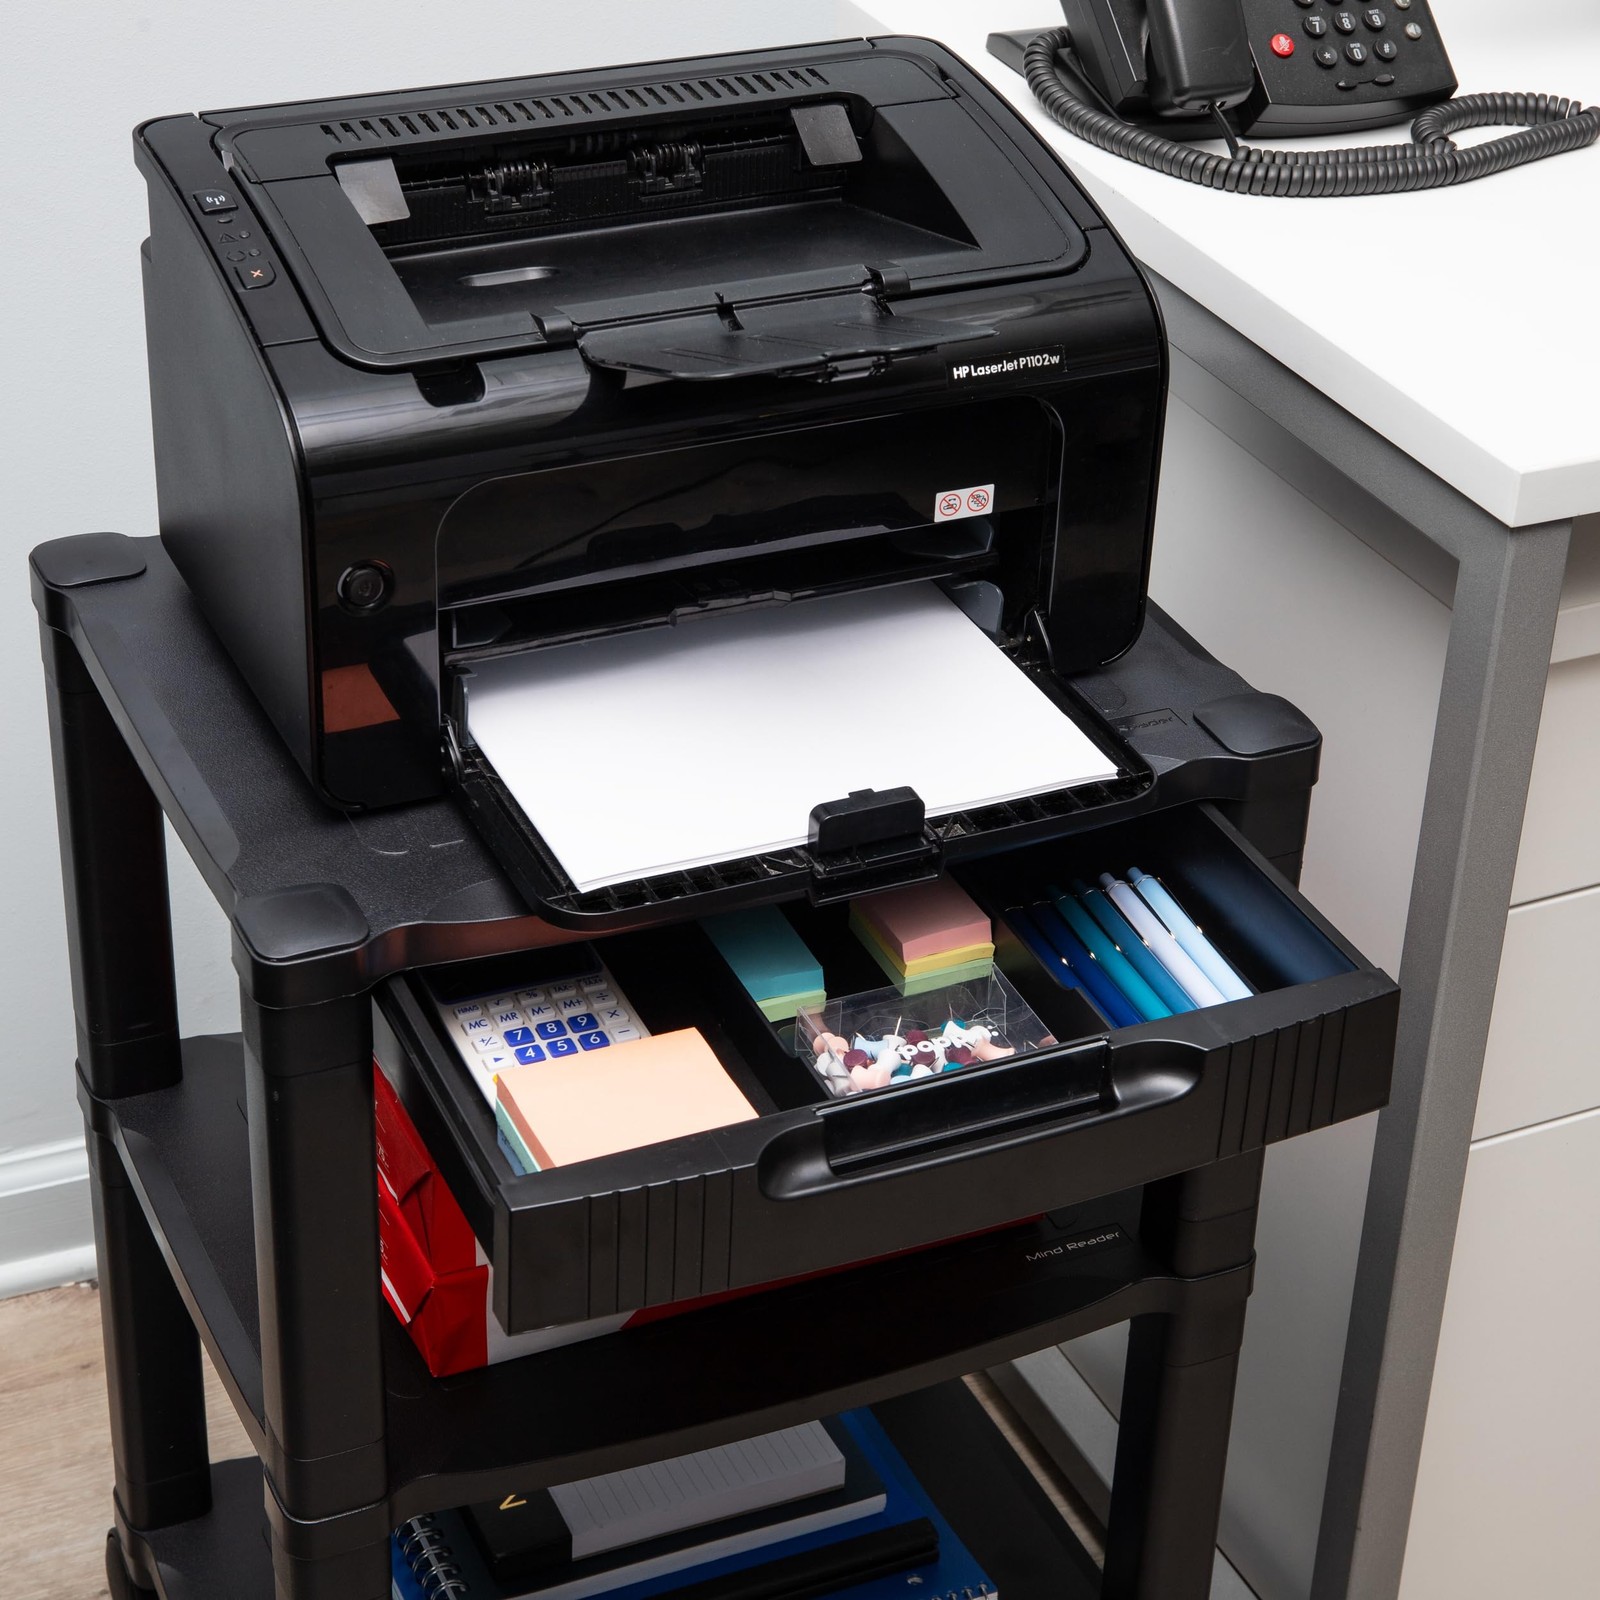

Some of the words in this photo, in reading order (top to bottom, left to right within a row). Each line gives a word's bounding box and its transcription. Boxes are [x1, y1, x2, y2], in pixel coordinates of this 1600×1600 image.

[1342, 17, 1351, 29] 8
[1372, 14, 1381, 26] 9
[1312, 21, 1320, 33] 7
[1353, 48, 1362, 60] 0
[1383, 43, 1390, 54] #
[953, 365, 970, 379] HP
[971, 359, 1018, 377] LaserJet
[1019, 353, 1060, 369] P1102w
[563, 998, 583, 1009] M+
[500, 1012, 519, 1022] MR
[577, 1015, 587, 1027] 9
[468, 1019, 488, 1030] MC
[546, 1022, 557, 1033] 8
[512, 1029, 522, 1041] 7
[589, 1033, 600, 1044] 6
[557, 1040, 568, 1051] 5
[525, 1046, 536, 1058] 4
[1025, 1246, 1063, 1262] Mind
[1066, 1231, 1120, 1251] Reader
